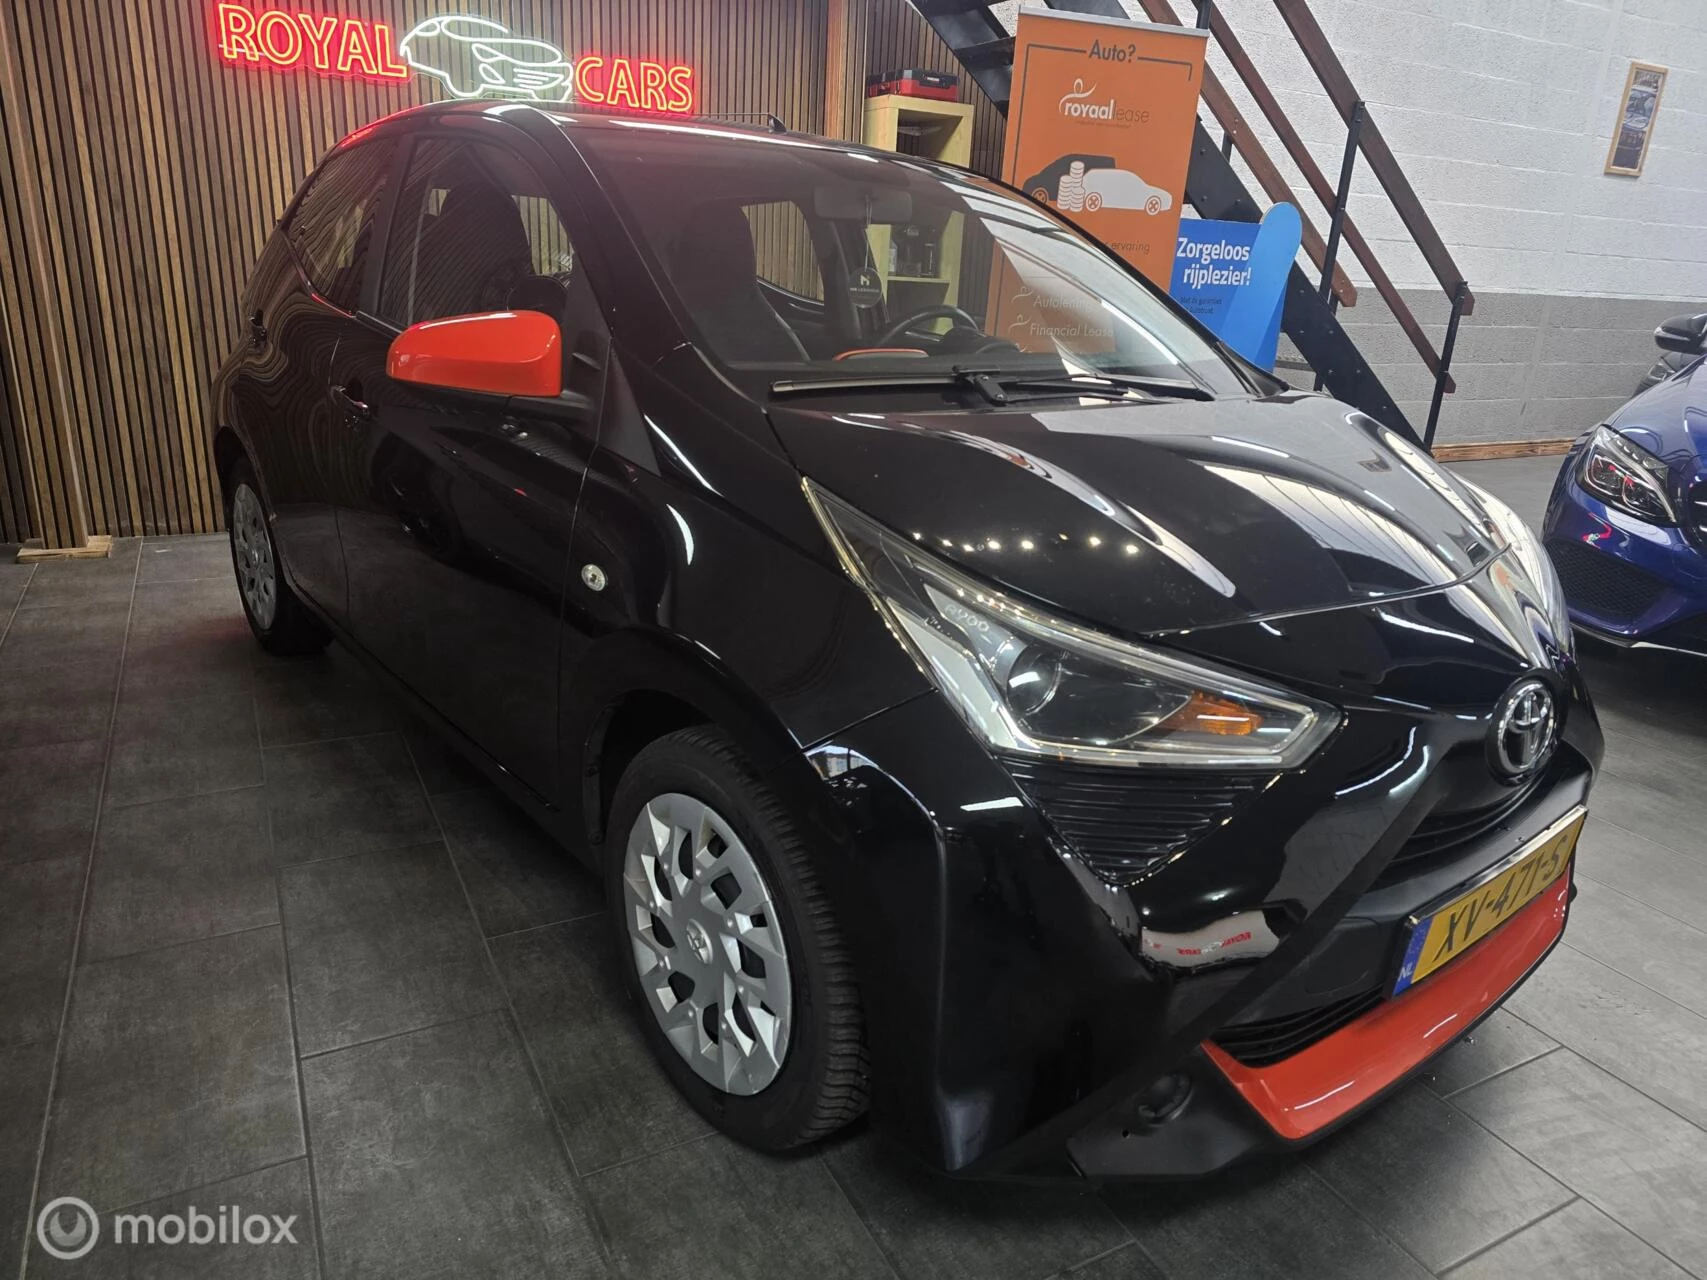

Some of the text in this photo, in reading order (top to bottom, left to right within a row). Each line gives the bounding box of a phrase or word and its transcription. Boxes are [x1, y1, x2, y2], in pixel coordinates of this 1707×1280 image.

[218, 3, 693, 112] ROYAL CARS
[1088, 39, 1137, 64] Auto?
[1176, 237, 1251, 264] Zorgeloos
[1183, 263, 1252, 289] rijplezier!
[1029, 322, 1114, 337] Financial Lease
[1431, 834, 1568, 963] XV-471-S
[1397, 961, 1414, 982] NL
